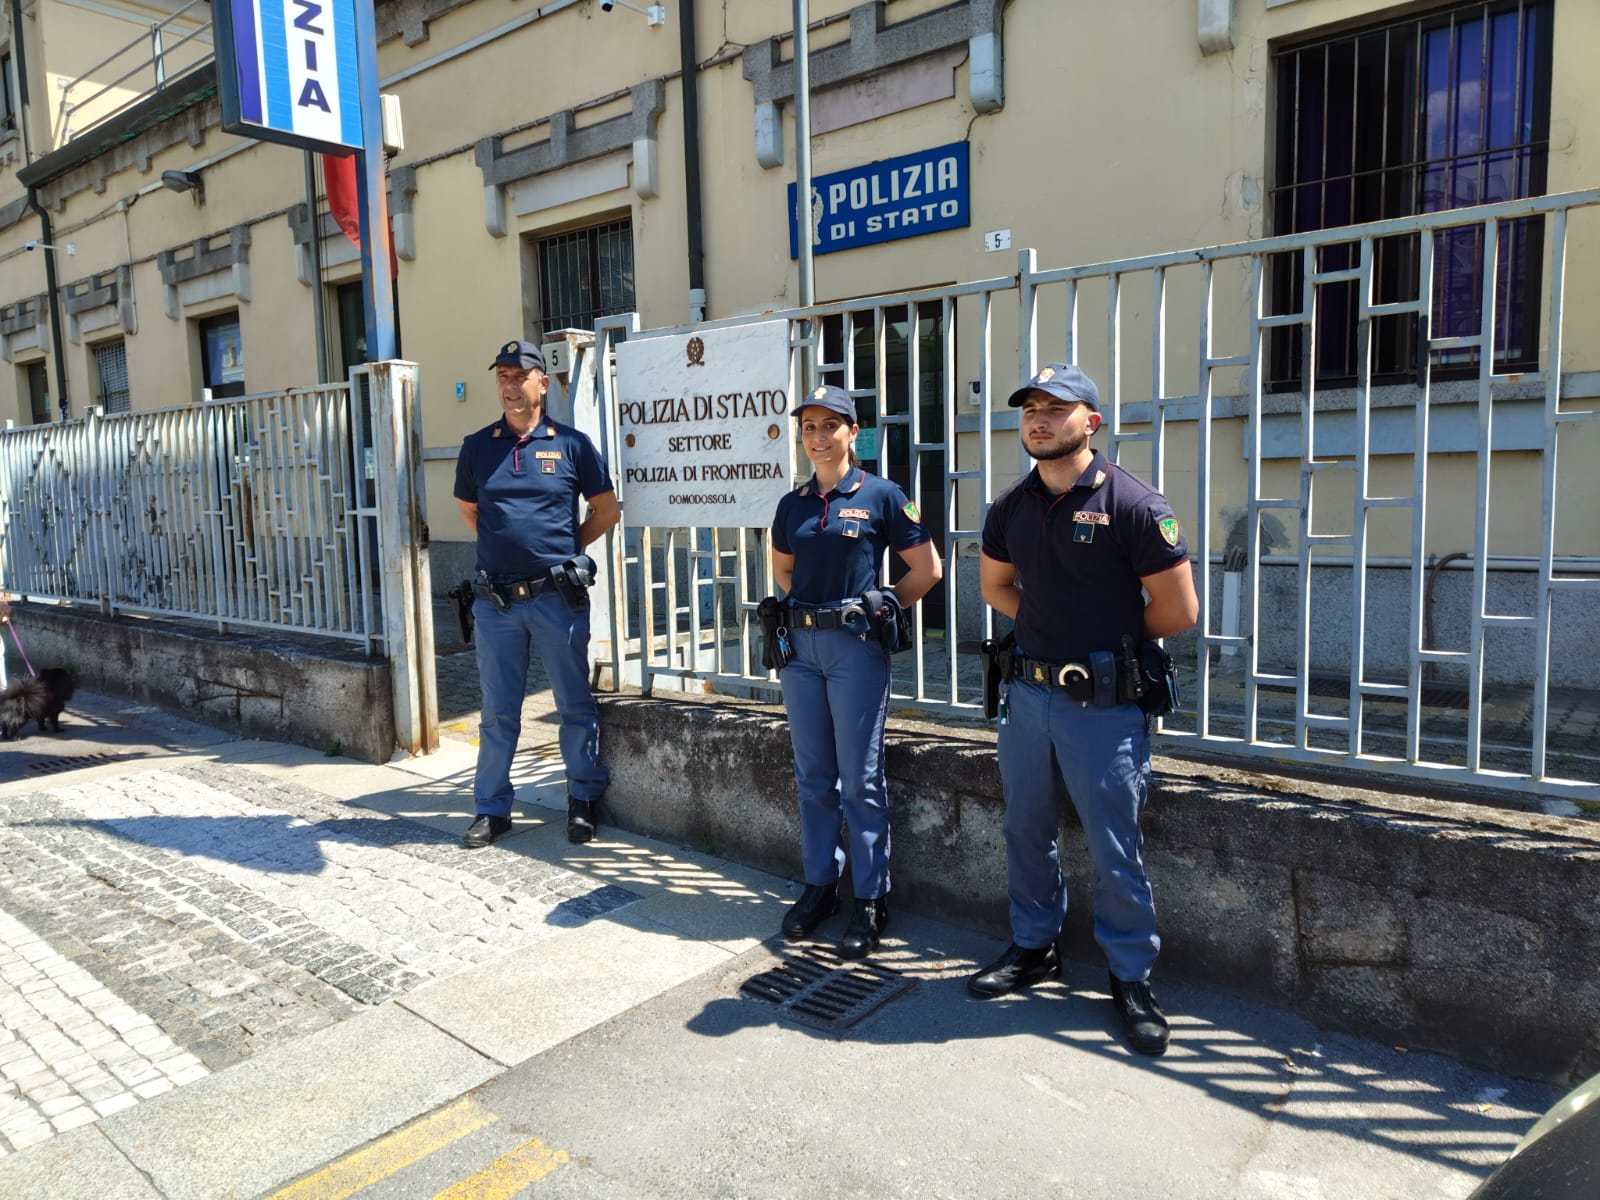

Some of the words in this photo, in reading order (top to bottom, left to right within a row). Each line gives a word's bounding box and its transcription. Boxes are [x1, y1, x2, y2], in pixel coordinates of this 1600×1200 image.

[829, 156, 958, 215] POLIZIA
[830, 221, 855, 241] DI
[866, 199, 959, 233] STATO
[994, 233, 1002, 248] 5
[552, 349, 559, 366] 5
[619, 398, 690, 426] POLIZIA
[694, 395, 713, 421] DI
[716, 389, 787, 420] STATO
[668, 433, 732, 452] SETTORE
[626, 465, 678, 484] POLIZIA
[683, 465, 697, 482] DI
[702, 462, 784, 481] FRONTIERA
[669, 494, 736, 505] DOMODOSSOLA
[1074, 511, 1109, 525] POLIZIA
